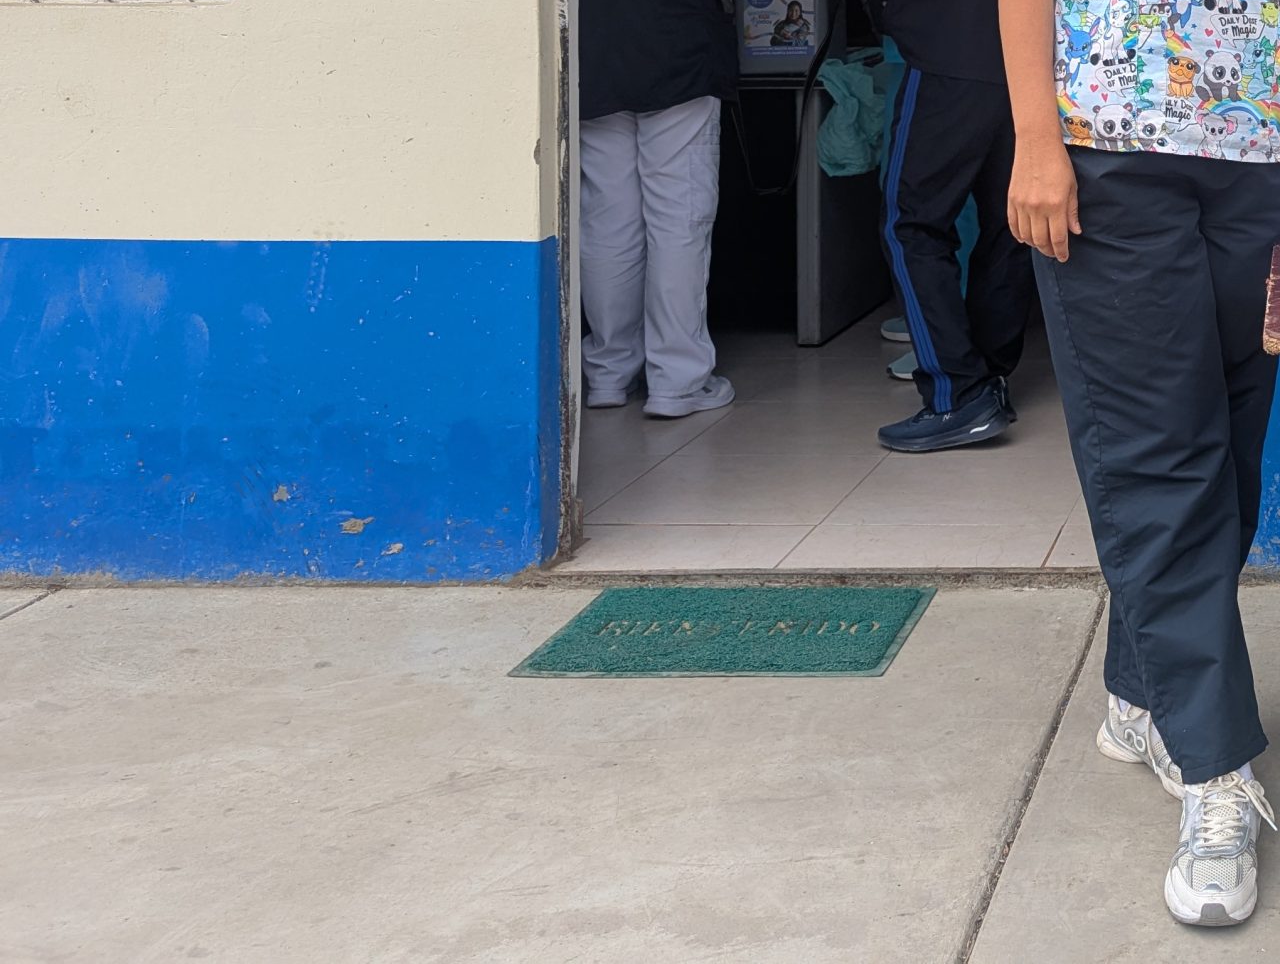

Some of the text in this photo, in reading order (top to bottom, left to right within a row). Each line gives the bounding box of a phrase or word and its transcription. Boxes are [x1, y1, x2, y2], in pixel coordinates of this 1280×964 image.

[1218, 15, 1258, 27] DAILY DOSE
[1221, 24, 1258, 39] OF Magic
[1103, 66, 1127, 79] DAILY
[1107, 79, 1116, 88] OF
[1165, 106, 1192, 123] Magic
